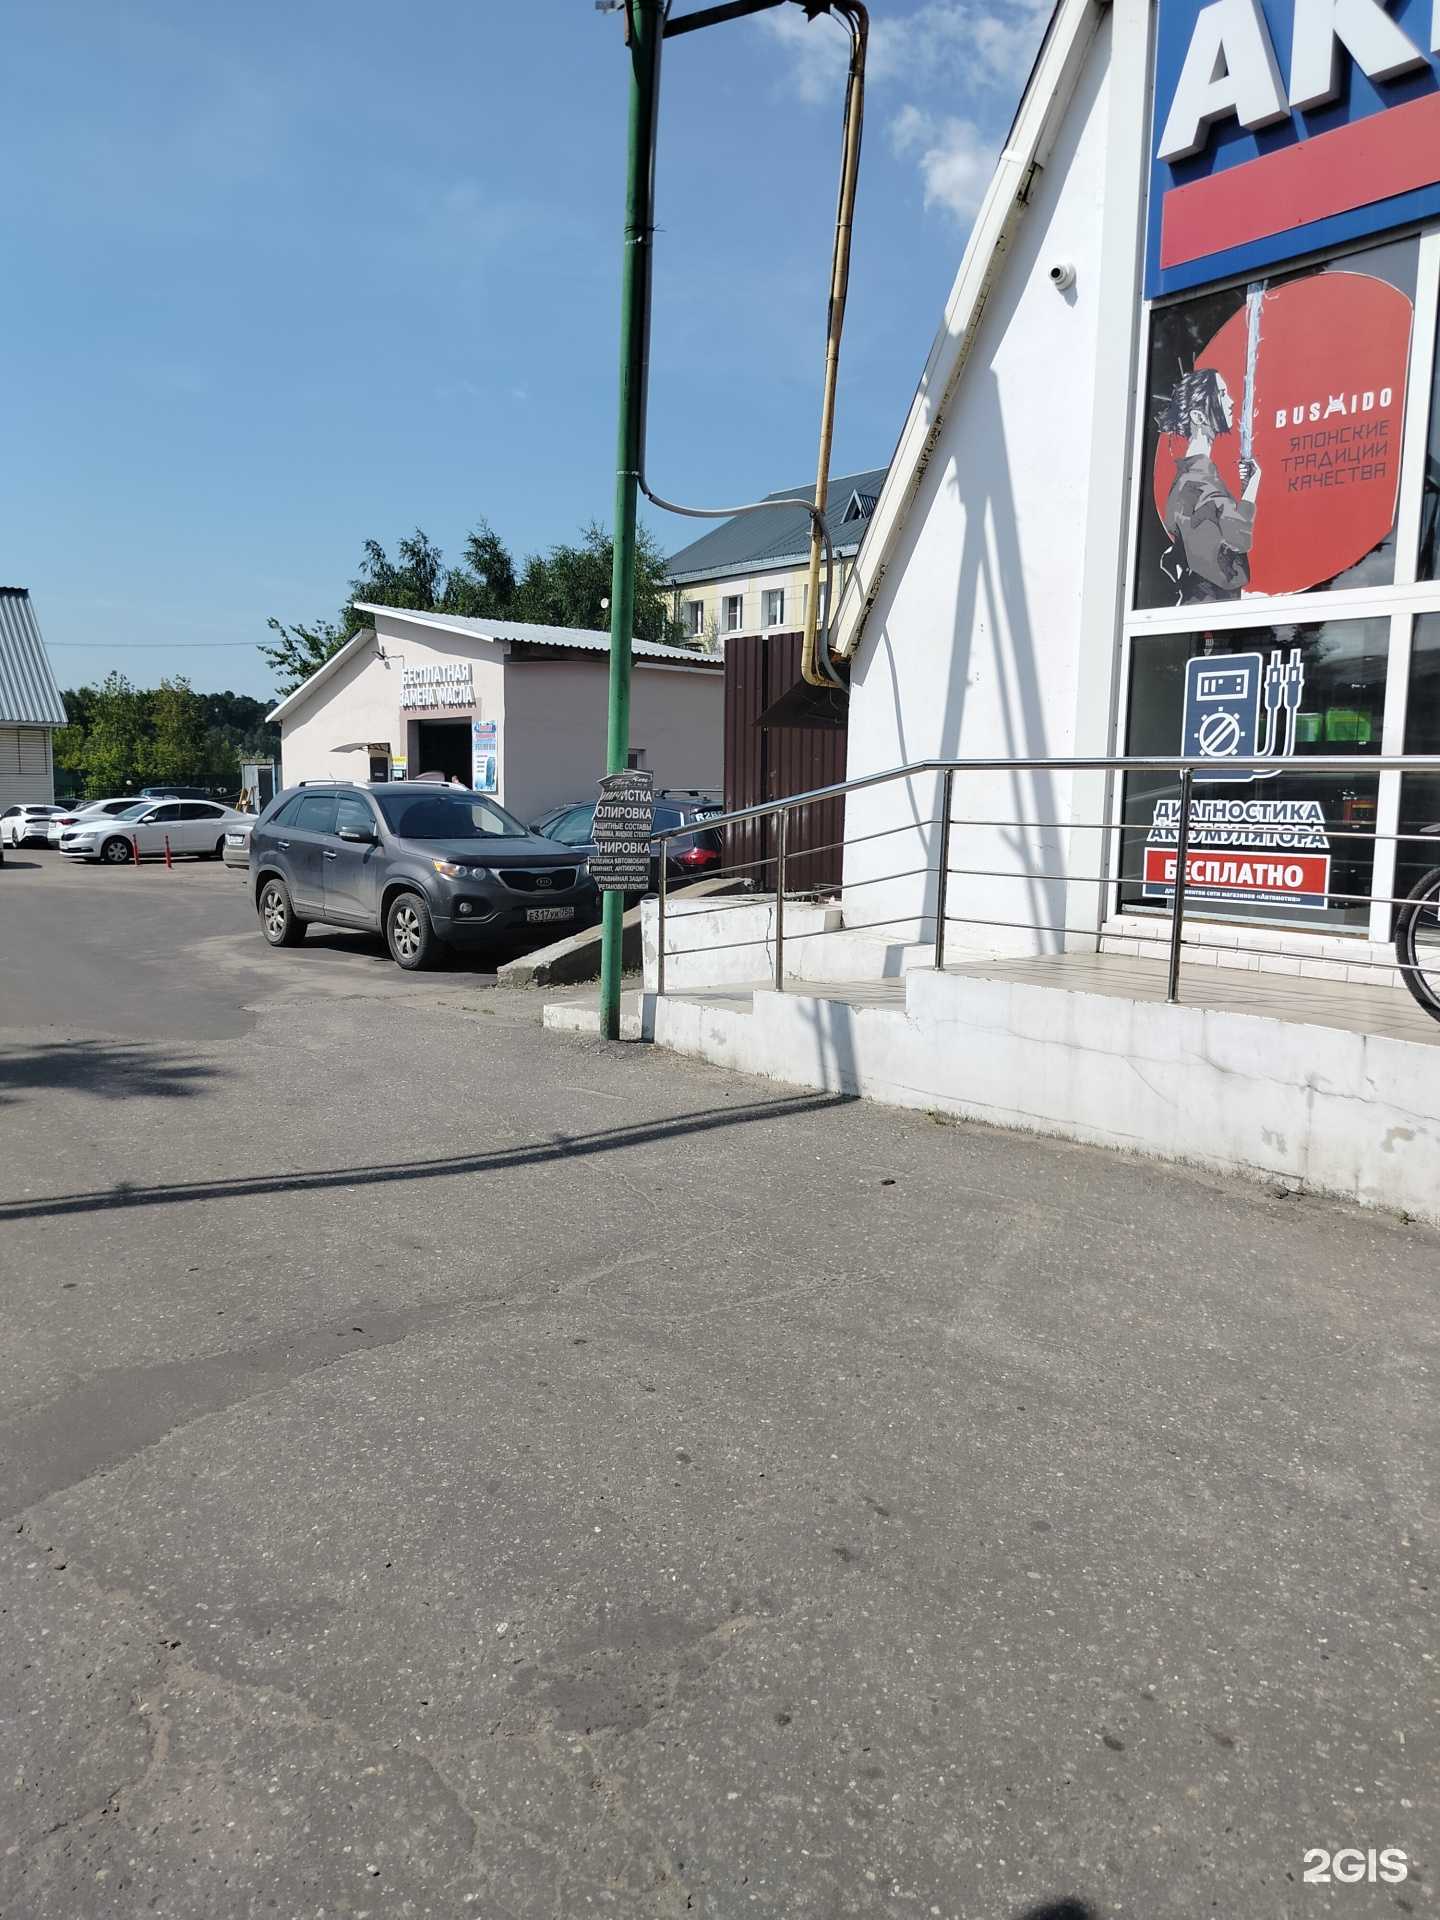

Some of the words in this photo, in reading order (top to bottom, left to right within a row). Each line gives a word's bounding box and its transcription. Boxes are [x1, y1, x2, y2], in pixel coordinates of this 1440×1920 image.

[1157, 0, 1440, 160] АК
[1289, 419, 1390, 452] ЯПОНСКИЕ
[1280, 441, 1388, 472] ТРАДИЦИИ
[1288, 462, 1386, 493] КАЧЕСТВА
[401, 664, 472, 684] БЕСПЛАТНАЯ
[440, 685, 474, 704] МАСЛА
[1155, 800, 1323, 823] ДИАГНОСТИКА
[1149, 823, 1328, 848] АКУМУЛЯТОРА
